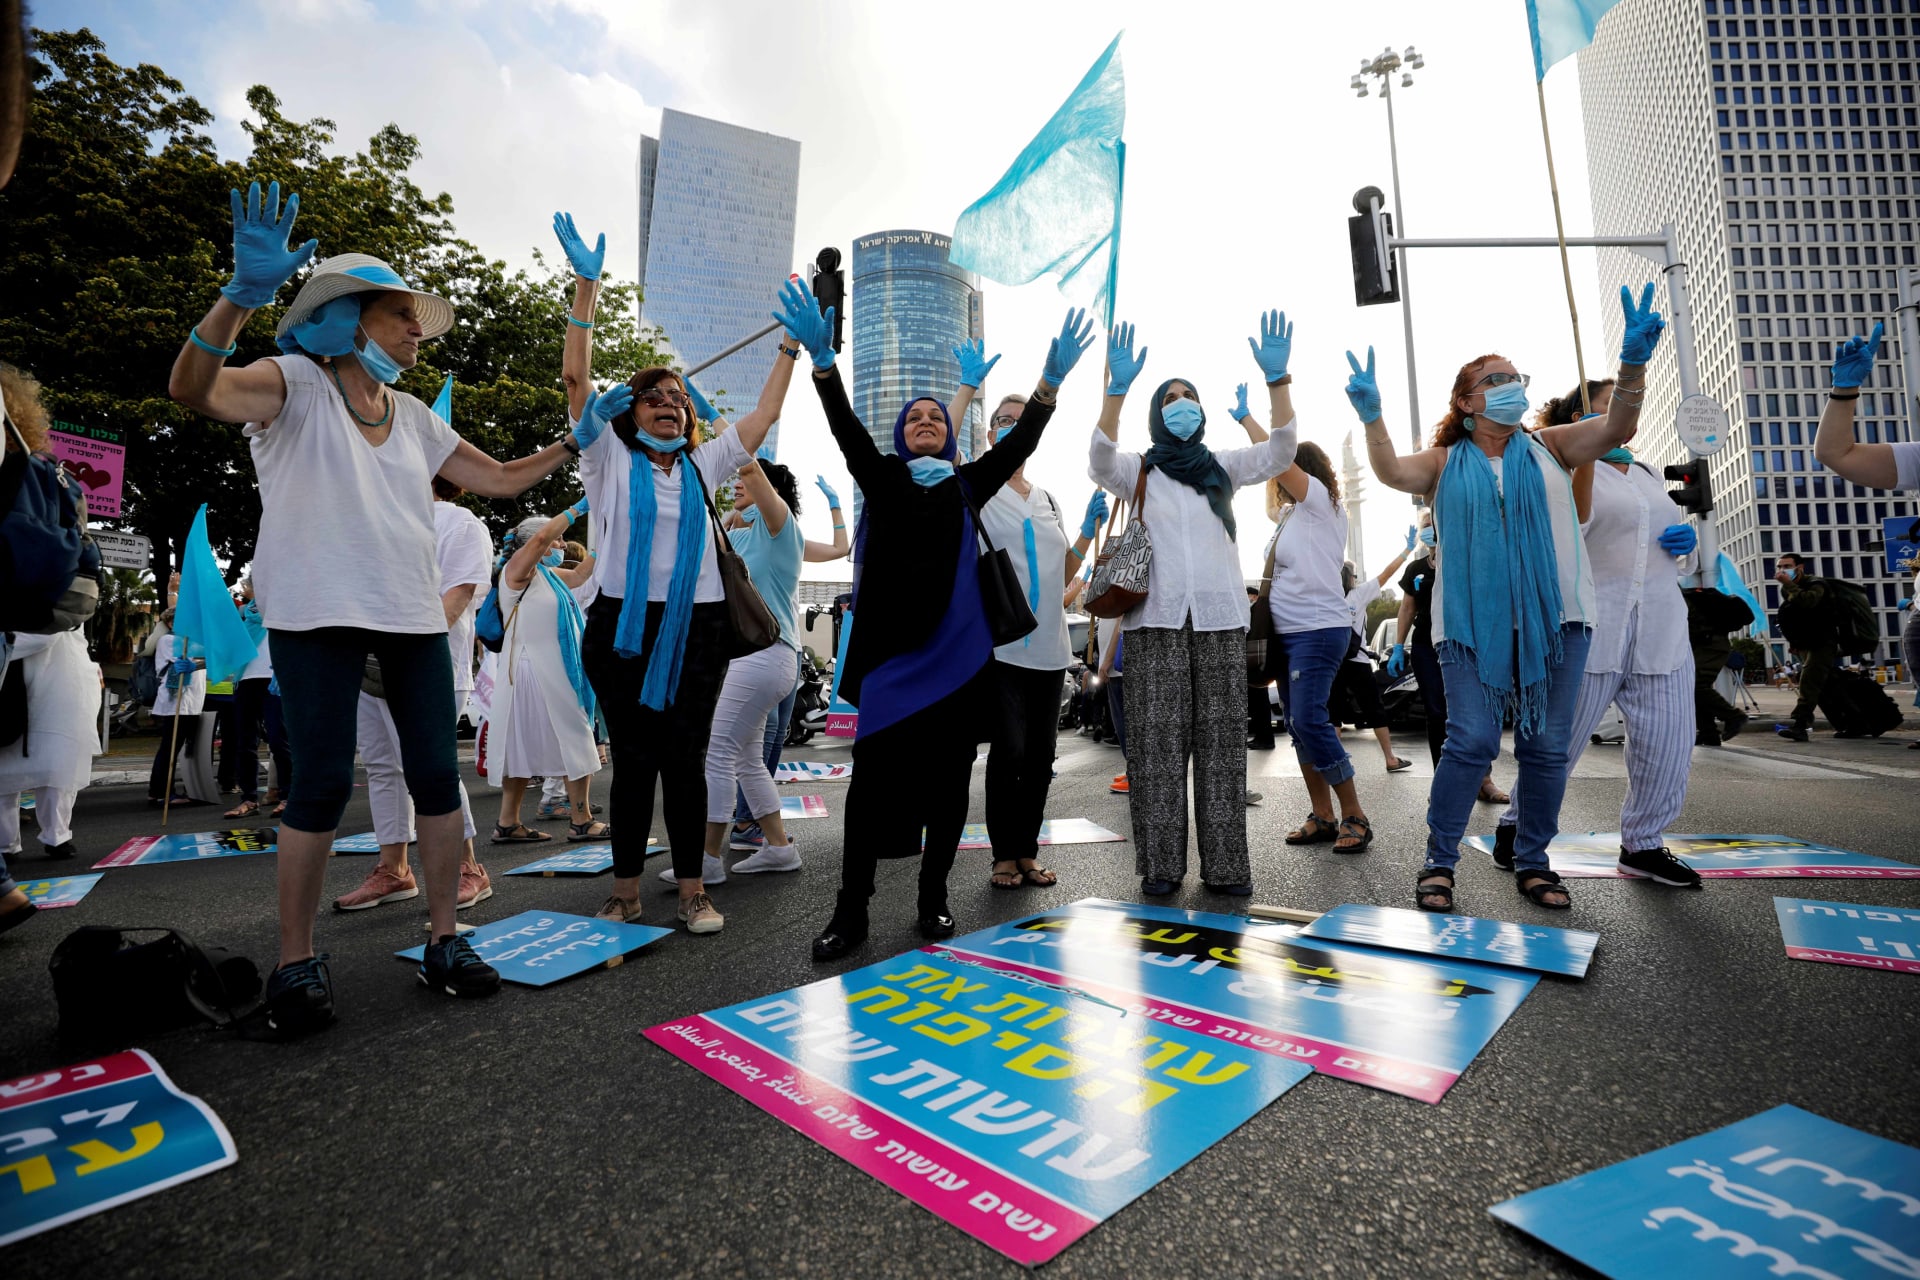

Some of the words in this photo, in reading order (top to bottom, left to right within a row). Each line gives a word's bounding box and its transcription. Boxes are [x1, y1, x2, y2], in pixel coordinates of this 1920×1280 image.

[860, 237, 885, 250] ישראל
[886, 234, 921, 244] אפריקה
[90, 427, 119, 441] מלון
[67, 447, 104, 460] להשכרה
[829, 721, 854, 731] السلام
[882, 963, 990, 1002] את
[735, 999, 899, 1062] שלום
[1128, 1003, 1202, 1027] שלום
[662, 1024, 723, 1050] السلام
[845, 984, 1181, 1117] הסיפוח
[971, 991, 1251, 1085] עוצרות
[1208, 1025, 1320, 1058] עושות
[705, 1049, 767, 1082] يصنعن
[1333, 1056, 1432, 1088] נשים
[813, 1105, 879, 1141] שלום
[869, 1059, 1152, 1181] עושות
[875, 1139, 969, 1191] עושות
[968, 1191, 1058, 1241] נשים
